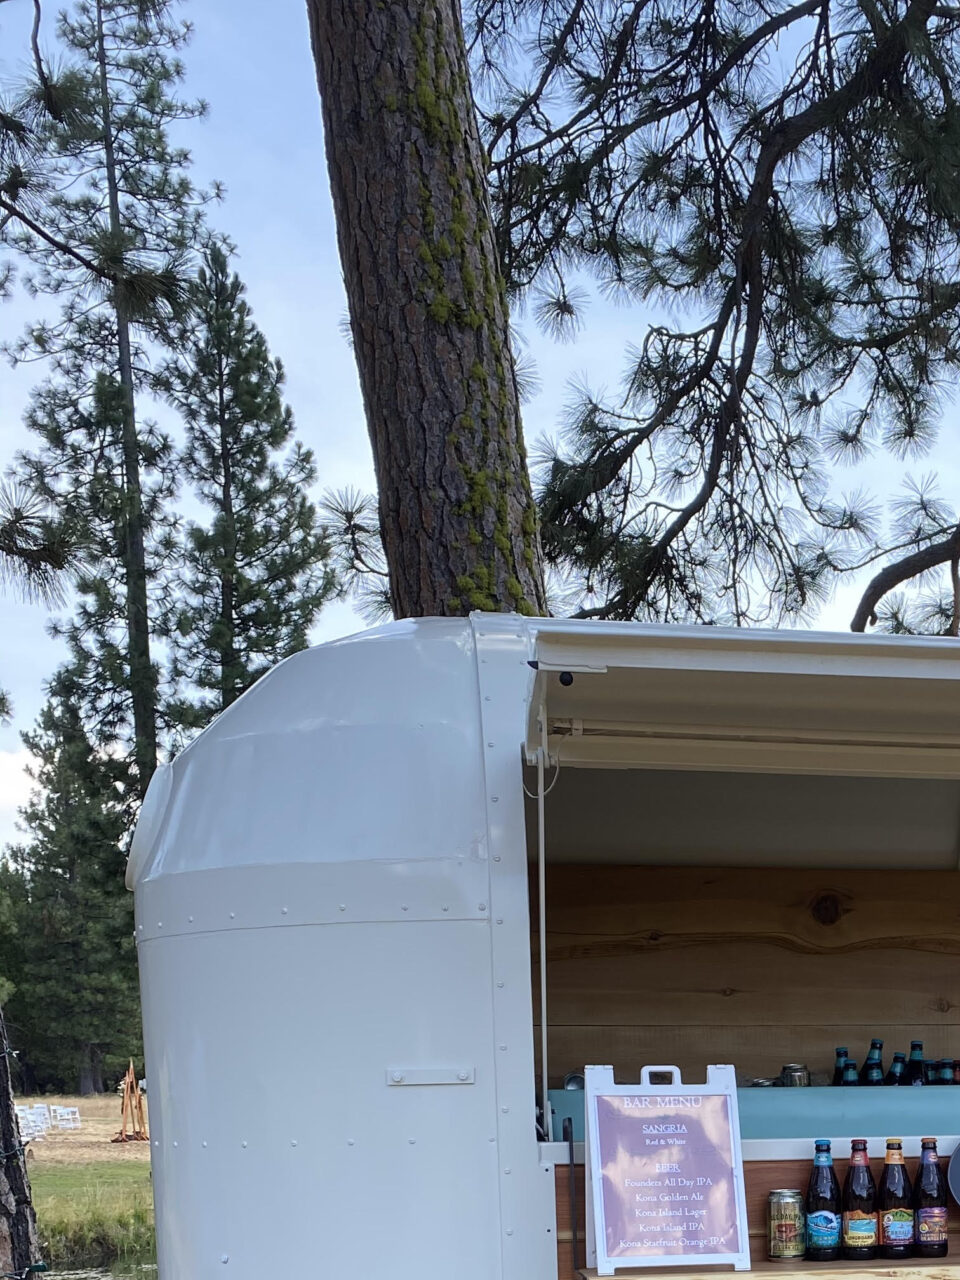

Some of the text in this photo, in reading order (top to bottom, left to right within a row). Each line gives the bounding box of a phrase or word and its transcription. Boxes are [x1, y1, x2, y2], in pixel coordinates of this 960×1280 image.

[624, 1097, 702, 1108] BAR MENU
[642, 1124, 688, 1134] SANGRIA
[656, 1163, 681, 1173] BEER
[624, 1178, 713, 1188] Founders All Day IPA
[636, 1193, 704, 1202] Kona Golden Ale
[635, 1208, 708, 1219] Kona Island Lager
[639, 1223, 705, 1232] Kona Island IPA
[620, 1239, 641, 1248] Kona
[642, 1239, 677, 1247] Starfruit
[679, 1238, 708, 1249] Orange
